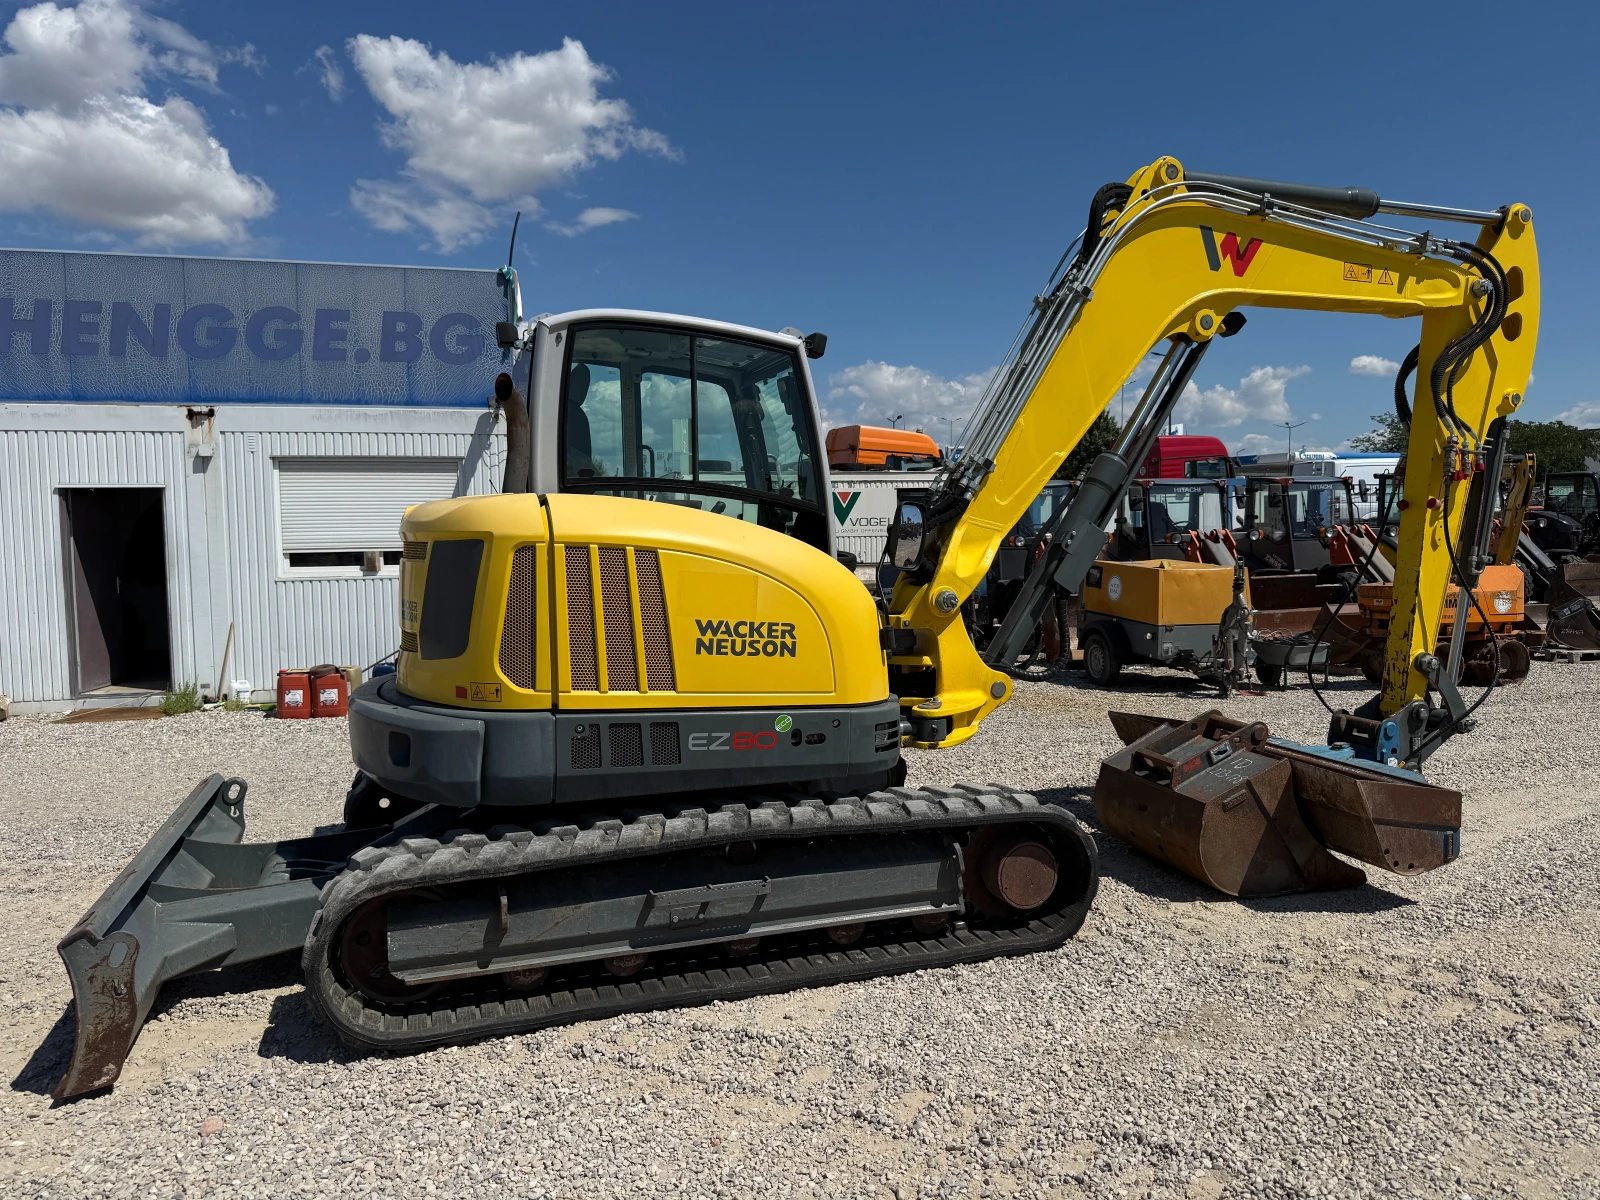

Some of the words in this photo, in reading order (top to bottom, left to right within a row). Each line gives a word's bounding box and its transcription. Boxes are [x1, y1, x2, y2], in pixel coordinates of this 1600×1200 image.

[695, 619, 797, 640] WACKER
[695, 638, 797, 657] NEUSON
[776, 717, 792, 731] ECO
[688, 731, 778, 751] EZ80
